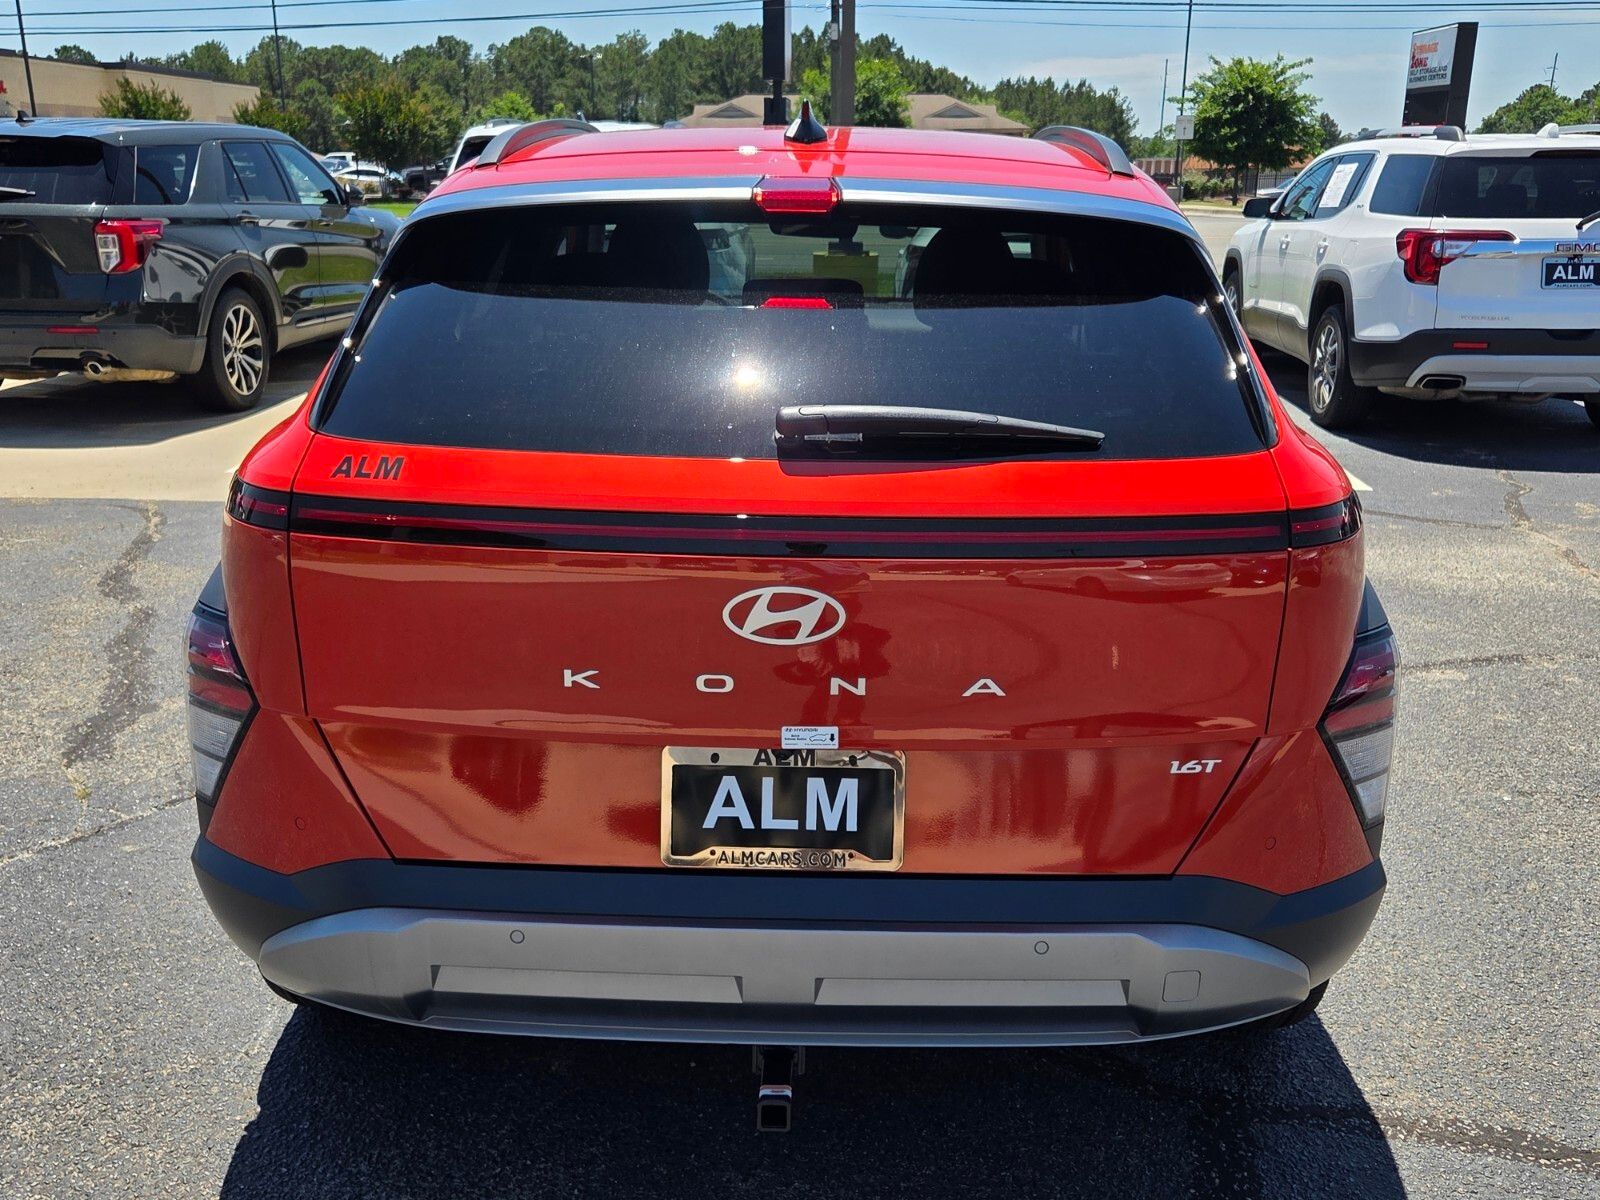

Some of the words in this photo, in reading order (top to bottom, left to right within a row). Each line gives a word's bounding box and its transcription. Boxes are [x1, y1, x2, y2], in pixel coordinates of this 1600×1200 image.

[1552, 265, 1594, 280] ALM
[330, 455, 405, 481] ALM
[563, 669, 1007, 698] KONA
[702, 775, 859, 832] ALM
[717, 850, 847, 868] ALMCARS.COM
